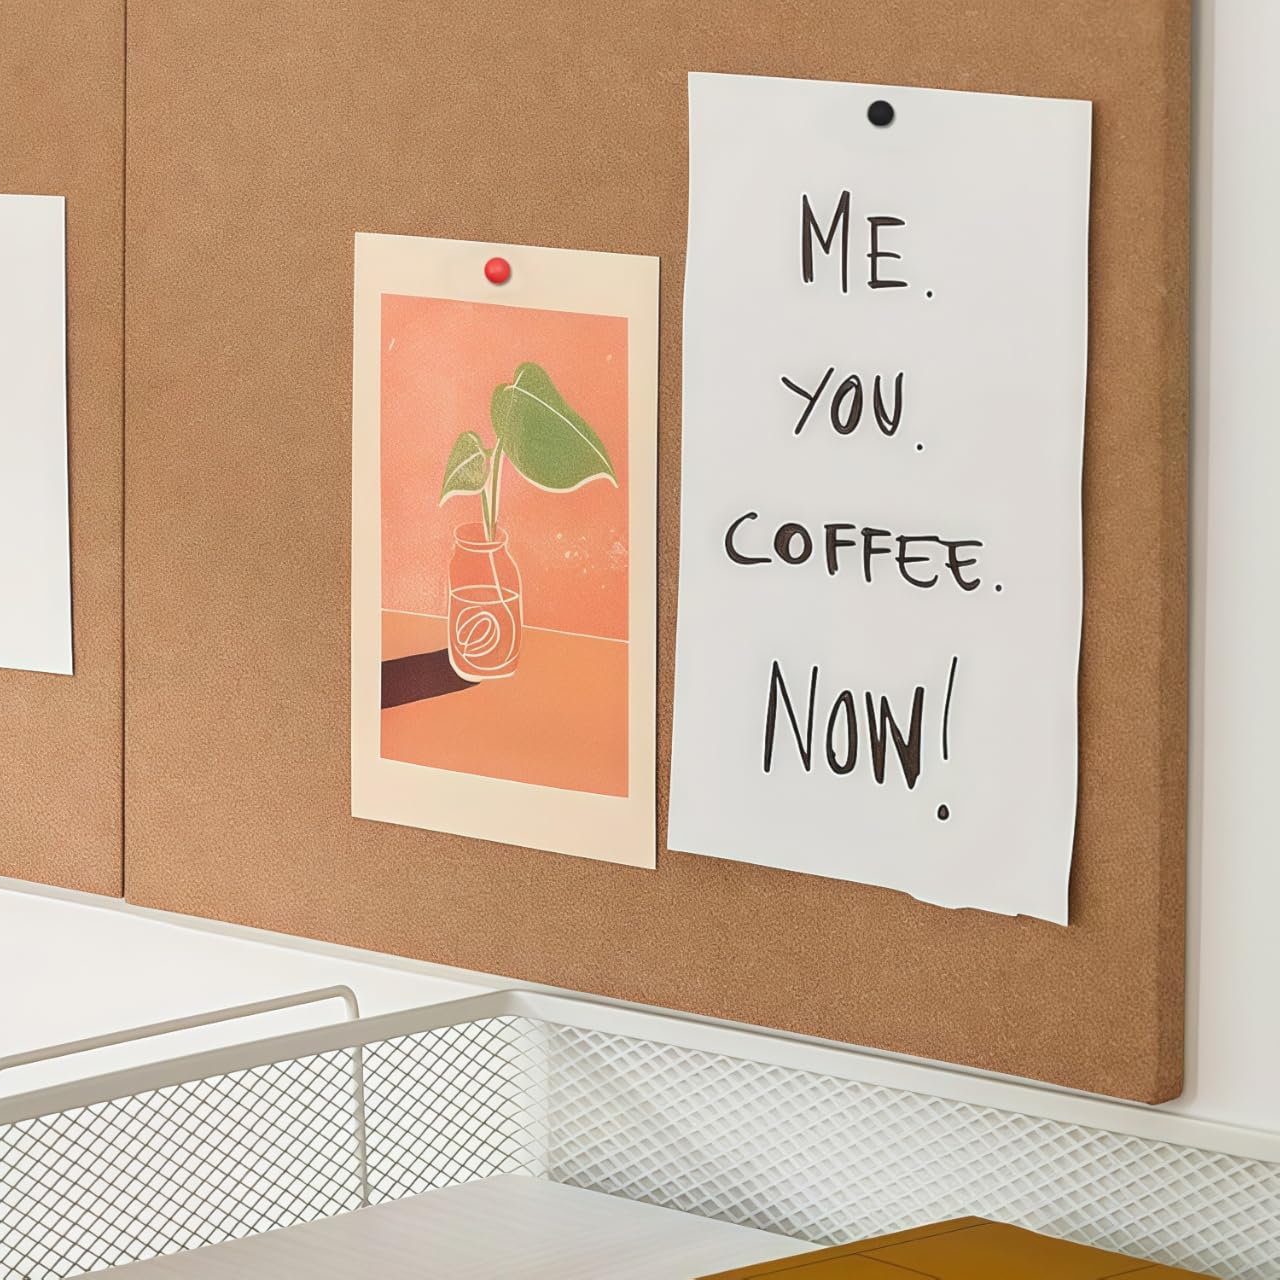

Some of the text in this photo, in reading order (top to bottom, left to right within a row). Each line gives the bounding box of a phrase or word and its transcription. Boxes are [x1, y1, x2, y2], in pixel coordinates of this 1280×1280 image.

[801, 189, 934, 299] ME.
[780, 366, 924, 452] YOU.
[724, 511, 1003, 592] COFFEE.
